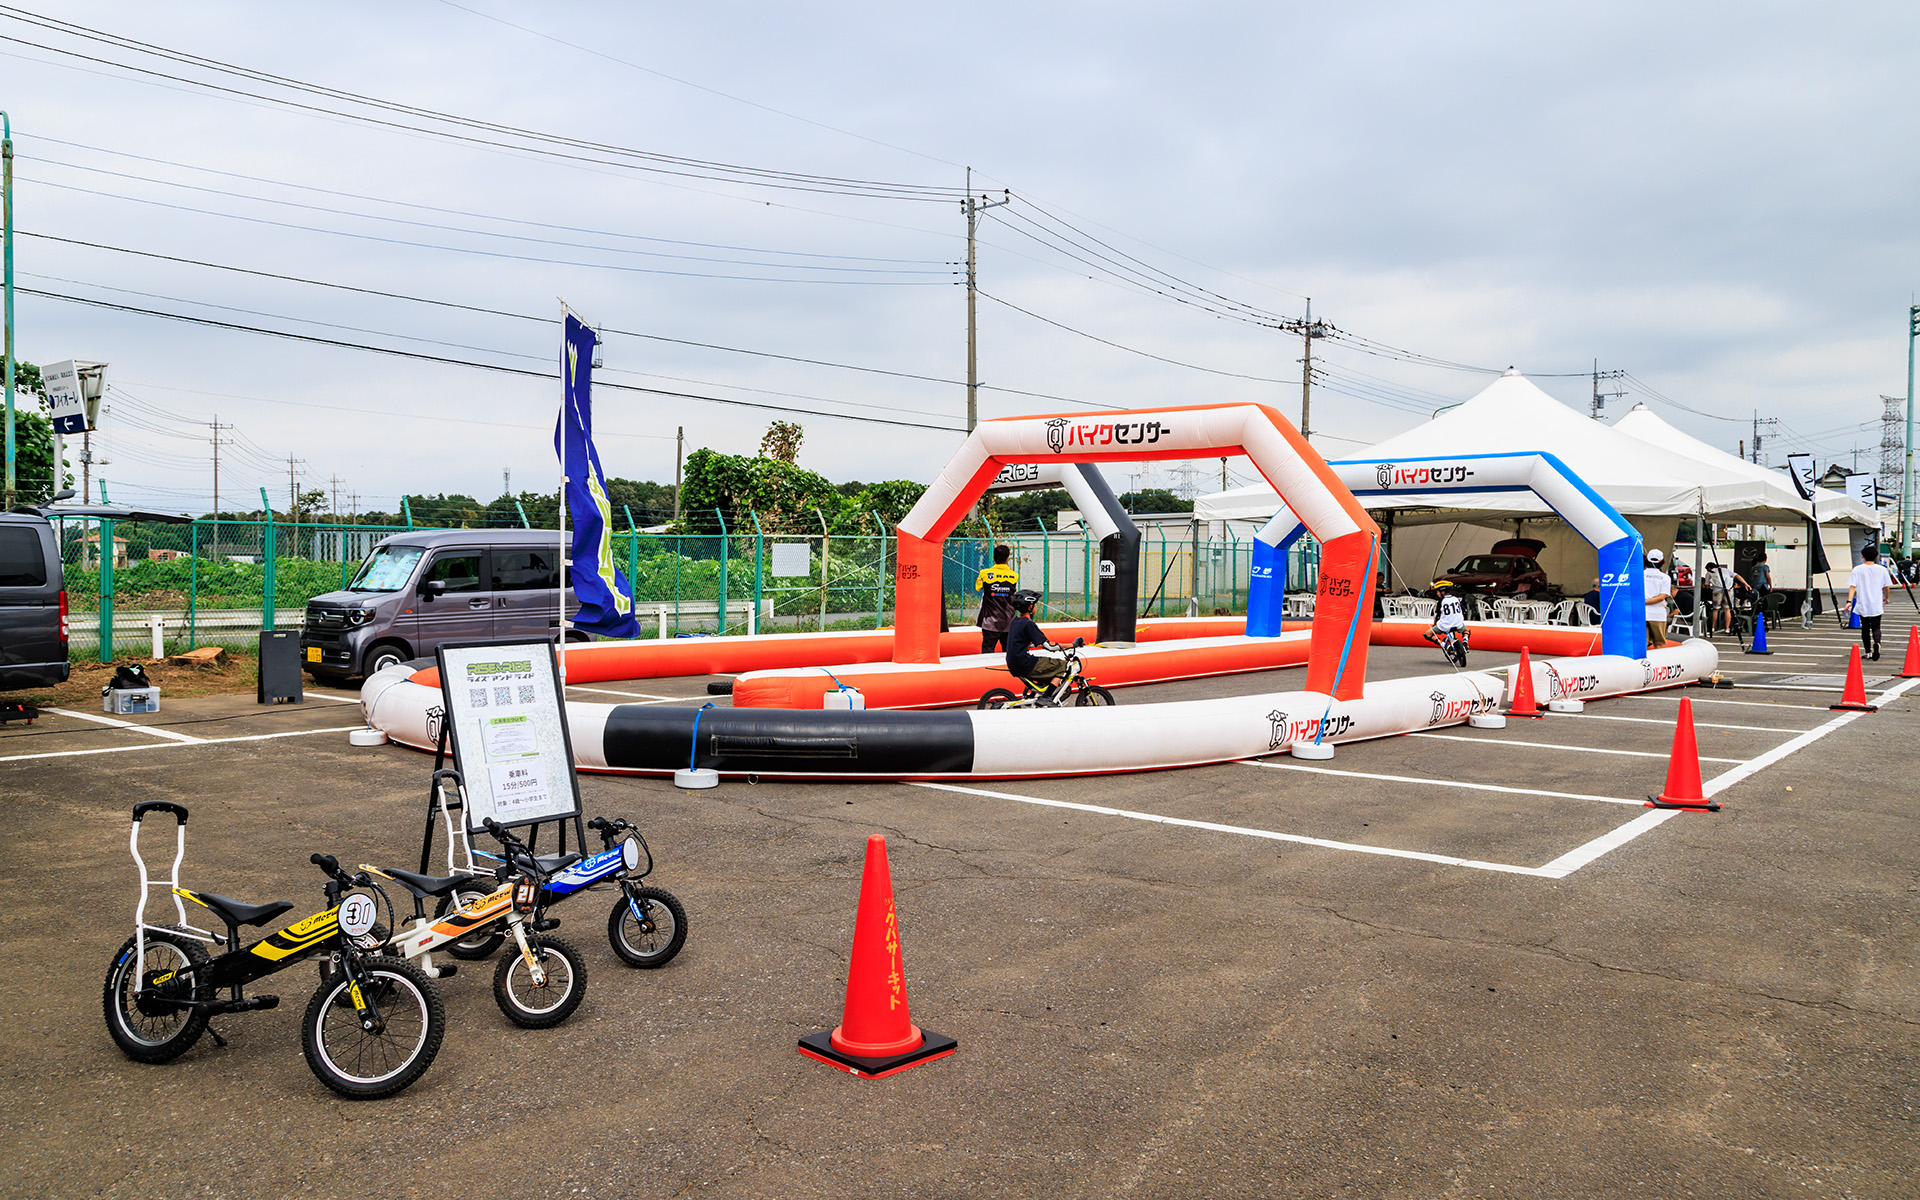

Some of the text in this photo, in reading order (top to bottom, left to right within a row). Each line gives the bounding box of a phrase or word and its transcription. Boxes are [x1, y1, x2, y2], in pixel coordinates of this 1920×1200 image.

[1068, 421, 1171, 446] バイクセンサー
[1394, 466, 1475, 484] バイクセンサー
[901, 564, 918, 573] バイク
[901, 572, 921, 580] センサー
[1329, 577, 1352, 588] バイク
[1329, 586, 1355, 597] センサー
[1443, 601, 1461, 616] 813
[467, 660, 532, 675] RISE&RIDE
[1651, 663, 1685, 682] バイクセンサー
[1560, 674, 1600, 694] バイクセンサー
[1285, 714, 1355, 743] バイクセンサー
[502, 778, 538, 791] 15分/500円
[516, 884, 536, 904] 21
[345, 901, 372, 926] 31
